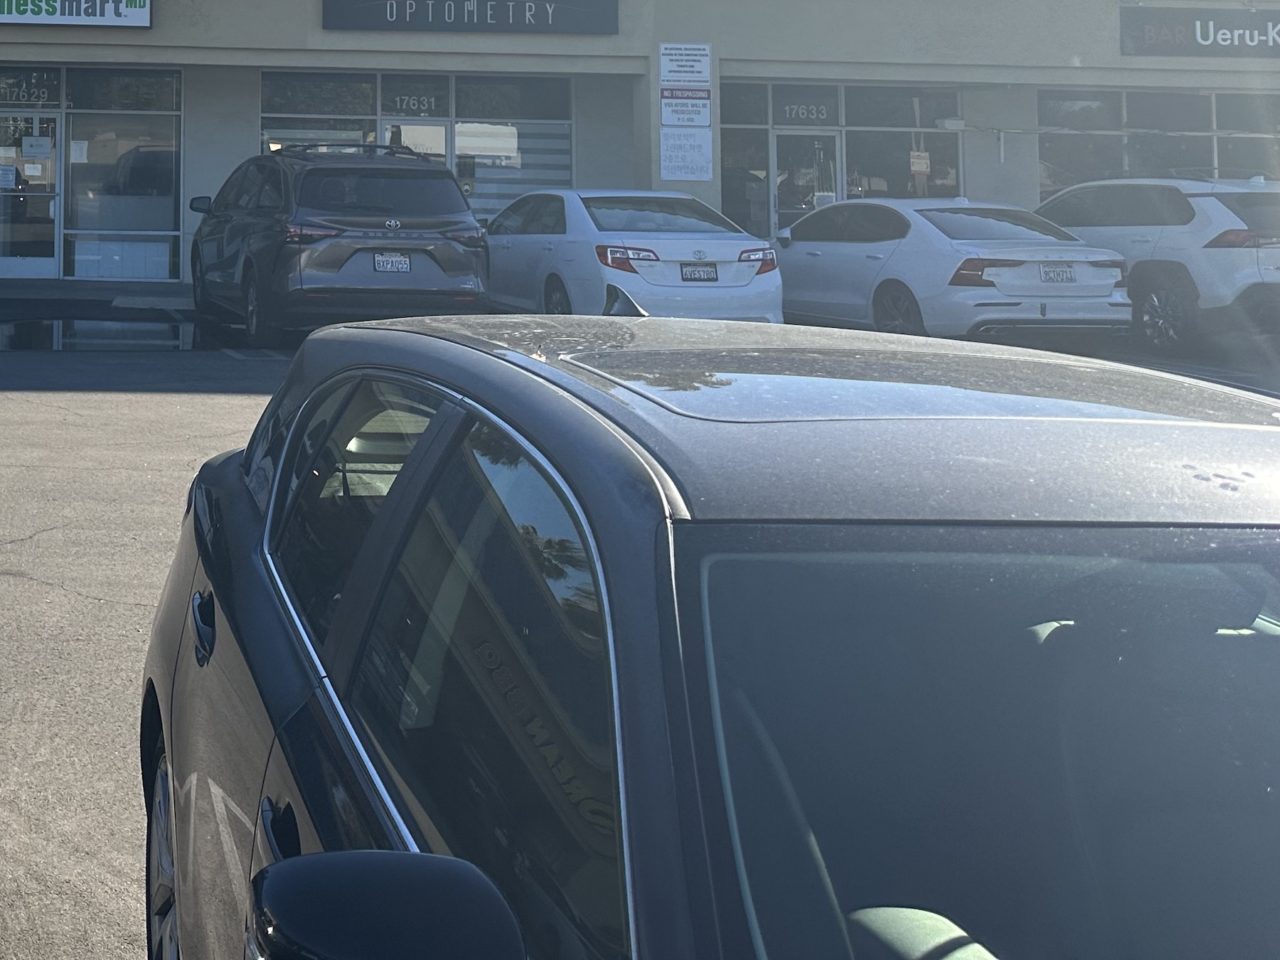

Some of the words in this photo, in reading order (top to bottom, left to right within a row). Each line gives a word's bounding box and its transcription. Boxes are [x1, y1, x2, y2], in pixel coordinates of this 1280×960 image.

[1144, 25, 1186, 45] BAR
[1195, 20, 1280, 46] Ueru-K
[6, 89, 48, 101] 17629
[394, 96, 435, 110] 17631
[784, 105, 827, 119] 17633
